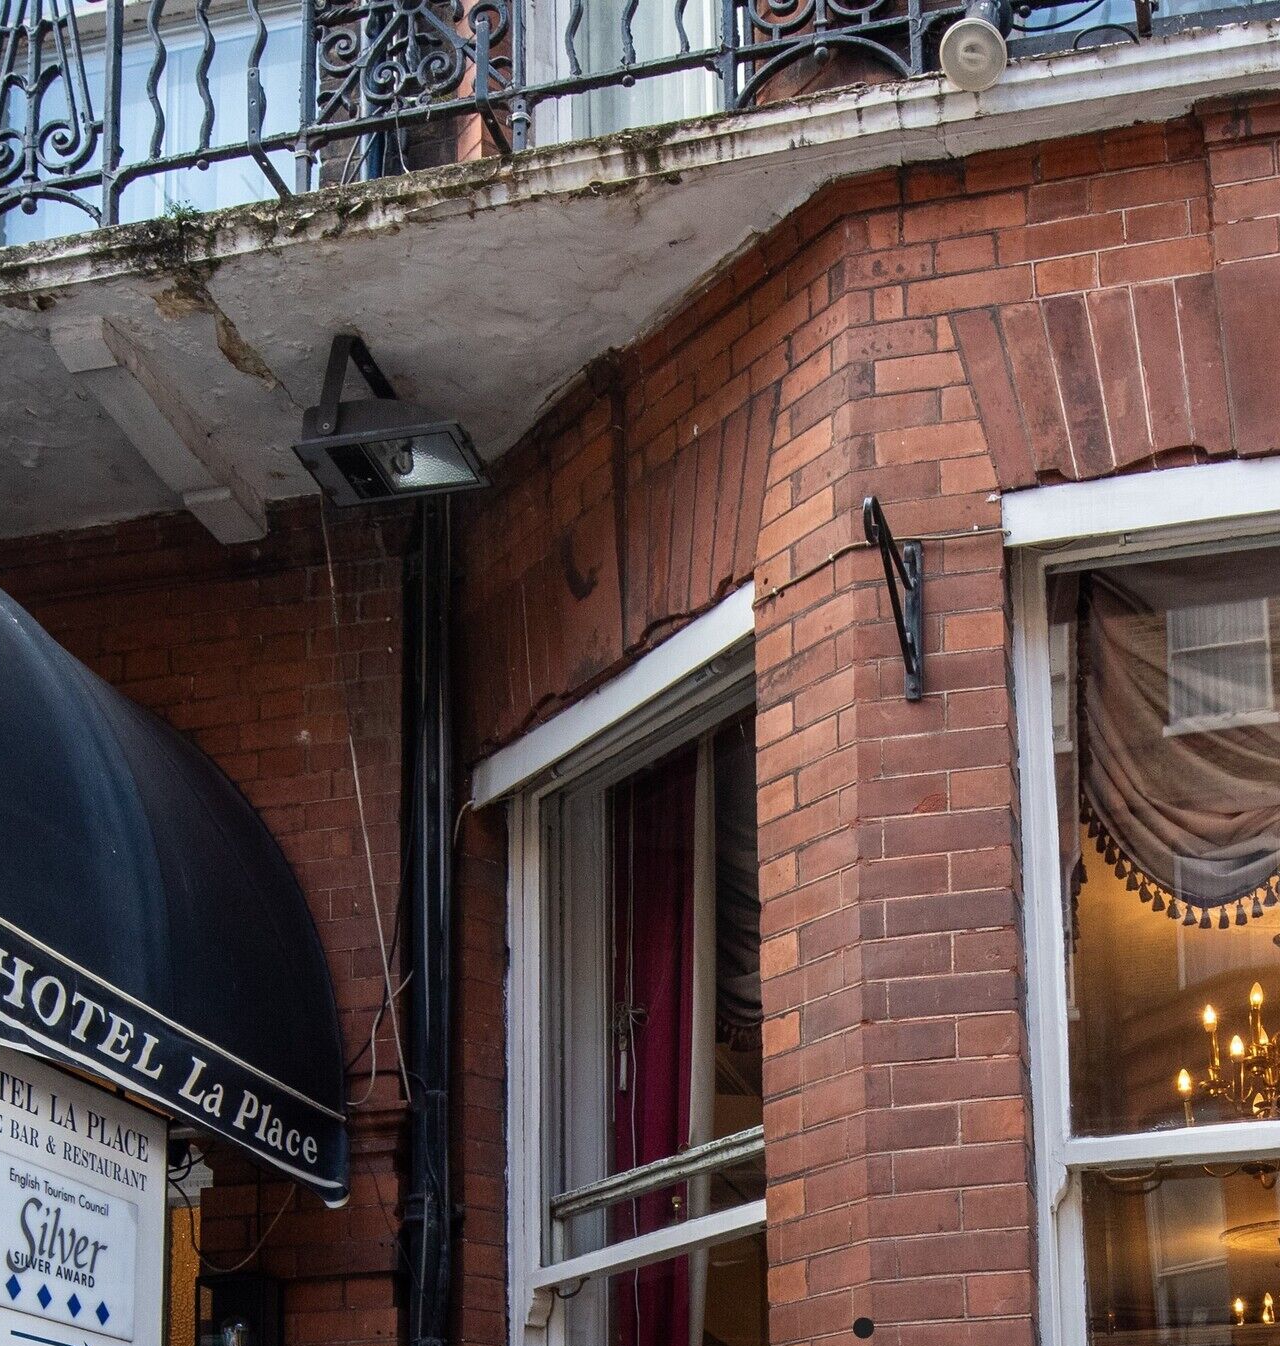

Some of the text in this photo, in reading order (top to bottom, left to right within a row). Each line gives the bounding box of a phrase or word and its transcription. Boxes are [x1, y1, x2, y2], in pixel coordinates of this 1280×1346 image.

[49, 1093, 78, 1132] LA
[86, 1110, 149, 1163] PLACE
[177, 1055, 225, 1118] La
[232, 1090, 319, 1165] Place
[10, 1118, 39, 1148] BAR
[45, 1135, 56, 1155] &
[63, 1141, 147, 1192] RESTAURANT
[9, 1167, 109, 1216] English Tourism Council
[6, 1197, 108, 1274] Silver
[14, 1251, 95, 1288] SILVER AWARD
